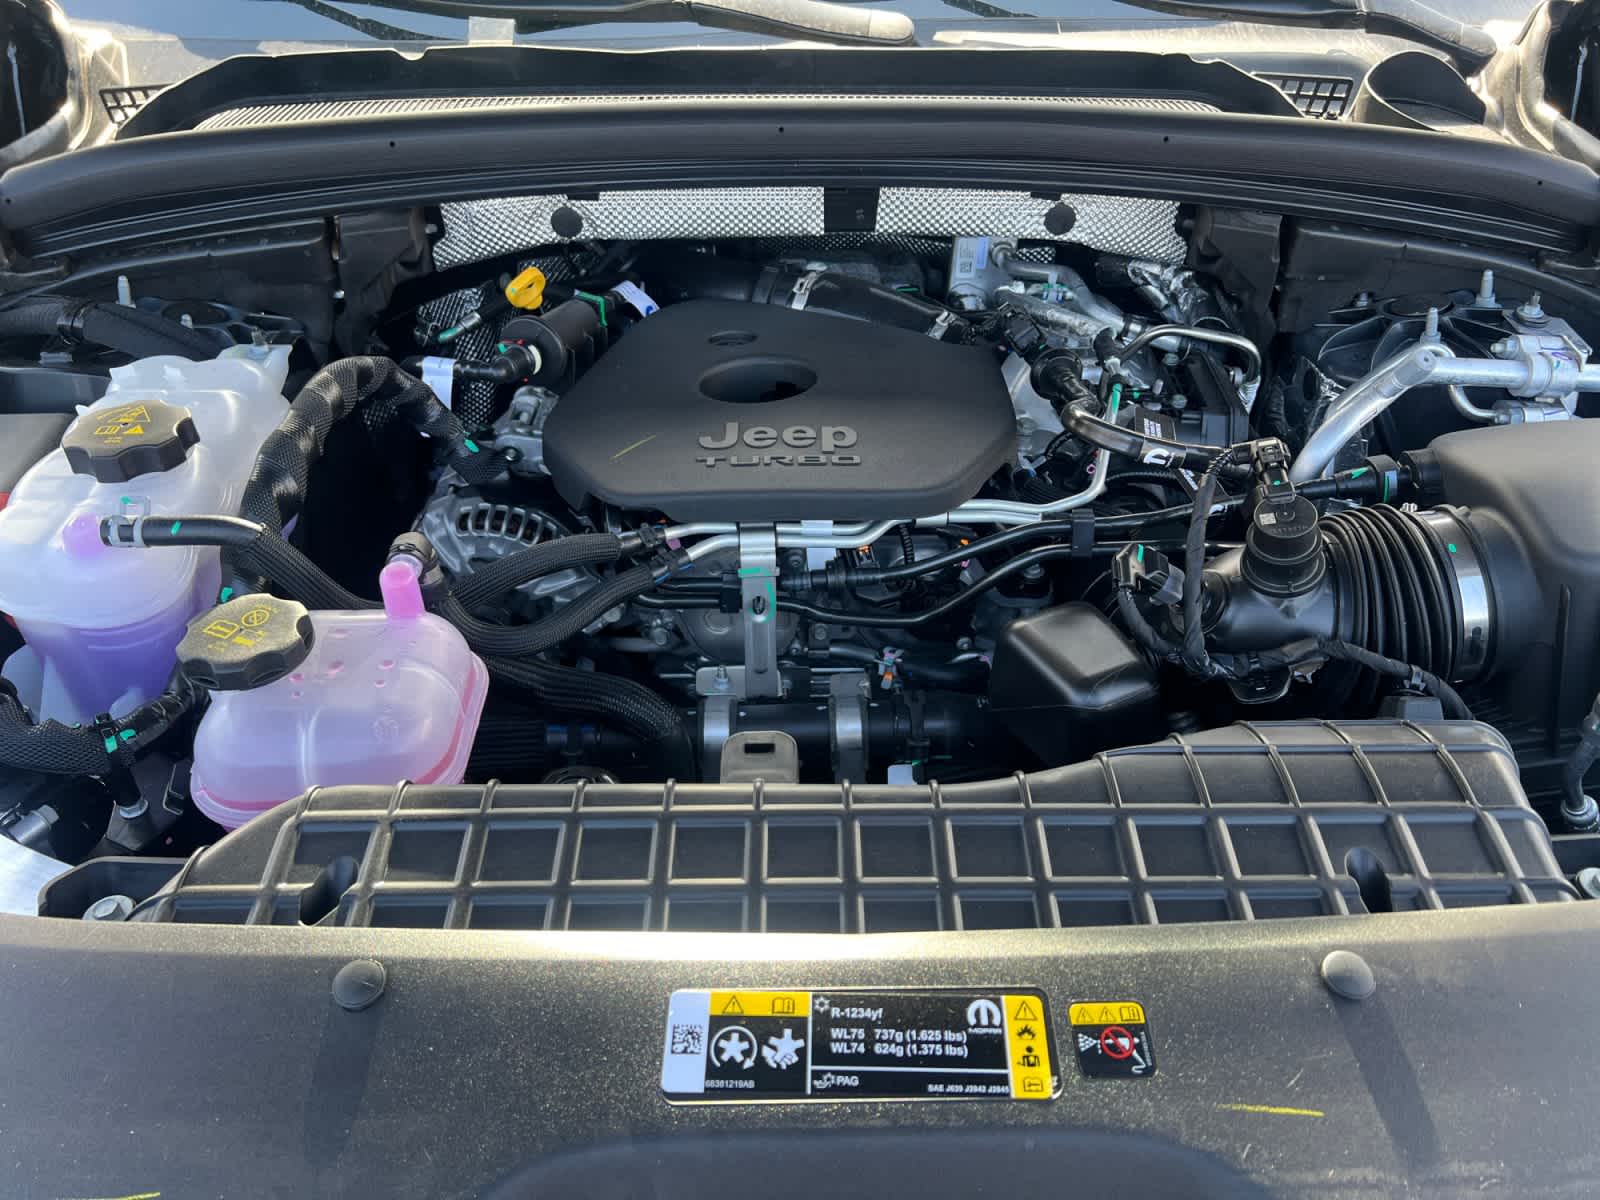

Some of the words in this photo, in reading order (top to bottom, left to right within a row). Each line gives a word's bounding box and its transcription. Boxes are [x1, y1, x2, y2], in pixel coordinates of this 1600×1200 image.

[698, 421, 857, 454] Jeep
[696, 455, 862, 467] TURBO
[831, 1007, 883, 1020] R-1234yf
[831, 1028, 866, 1040] WL75
[875, 1029, 903, 1043] 737g
[906, 1029, 943, 1043] (1.625
[945, 1030, 968, 1044] lbs)
[831, 1042, 866, 1054] WL74
[874, 1043, 904, 1057] 624g
[907, 1043, 943, 1056] (1.375
[945, 1044, 969, 1058] lbs)
[836, 1075, 860, 1087] PAG
